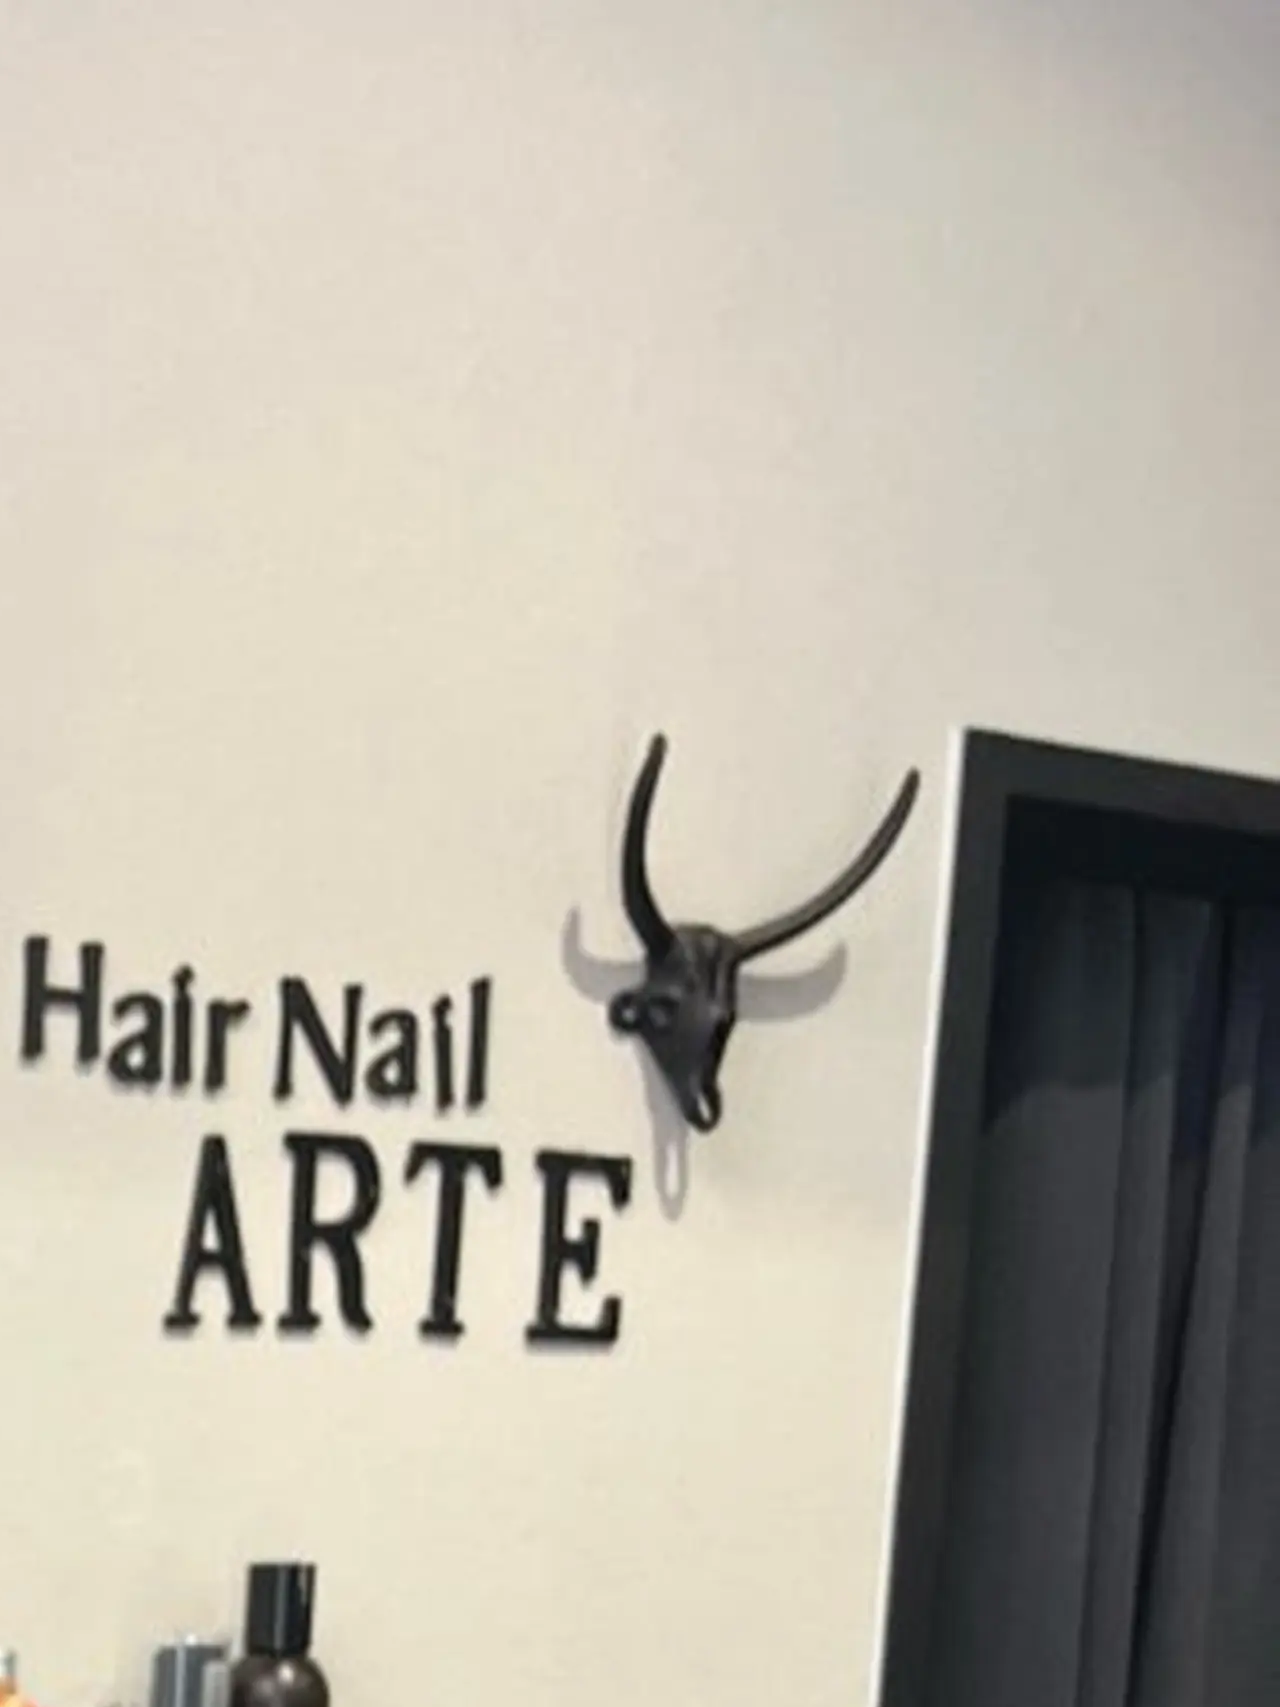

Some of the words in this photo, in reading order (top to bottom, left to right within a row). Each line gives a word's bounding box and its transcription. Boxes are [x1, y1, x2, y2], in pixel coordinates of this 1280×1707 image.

[21, 935, 249, 1092] Hair
[274, 975, 491, 1110] Nail
[163, 1131, 633, 1346] ARTE
